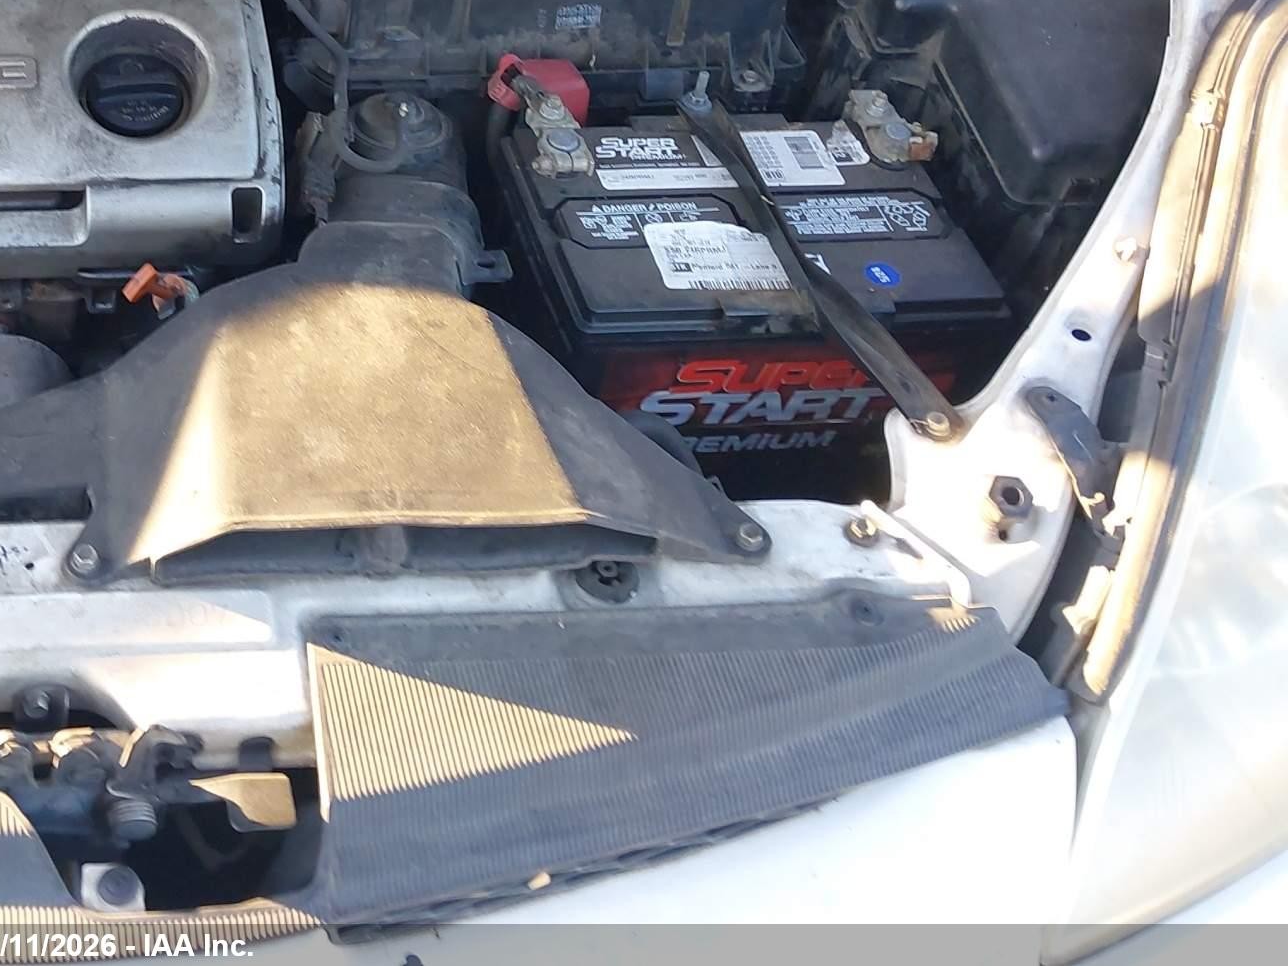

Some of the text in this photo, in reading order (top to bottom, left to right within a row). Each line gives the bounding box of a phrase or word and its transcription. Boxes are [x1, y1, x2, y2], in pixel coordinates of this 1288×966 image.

[600, 137, 679, 150] SUPER
[595, 146, 679, 158] START
[657, 202, 698, 211] POISON
[640, 387, 887, 426] START
